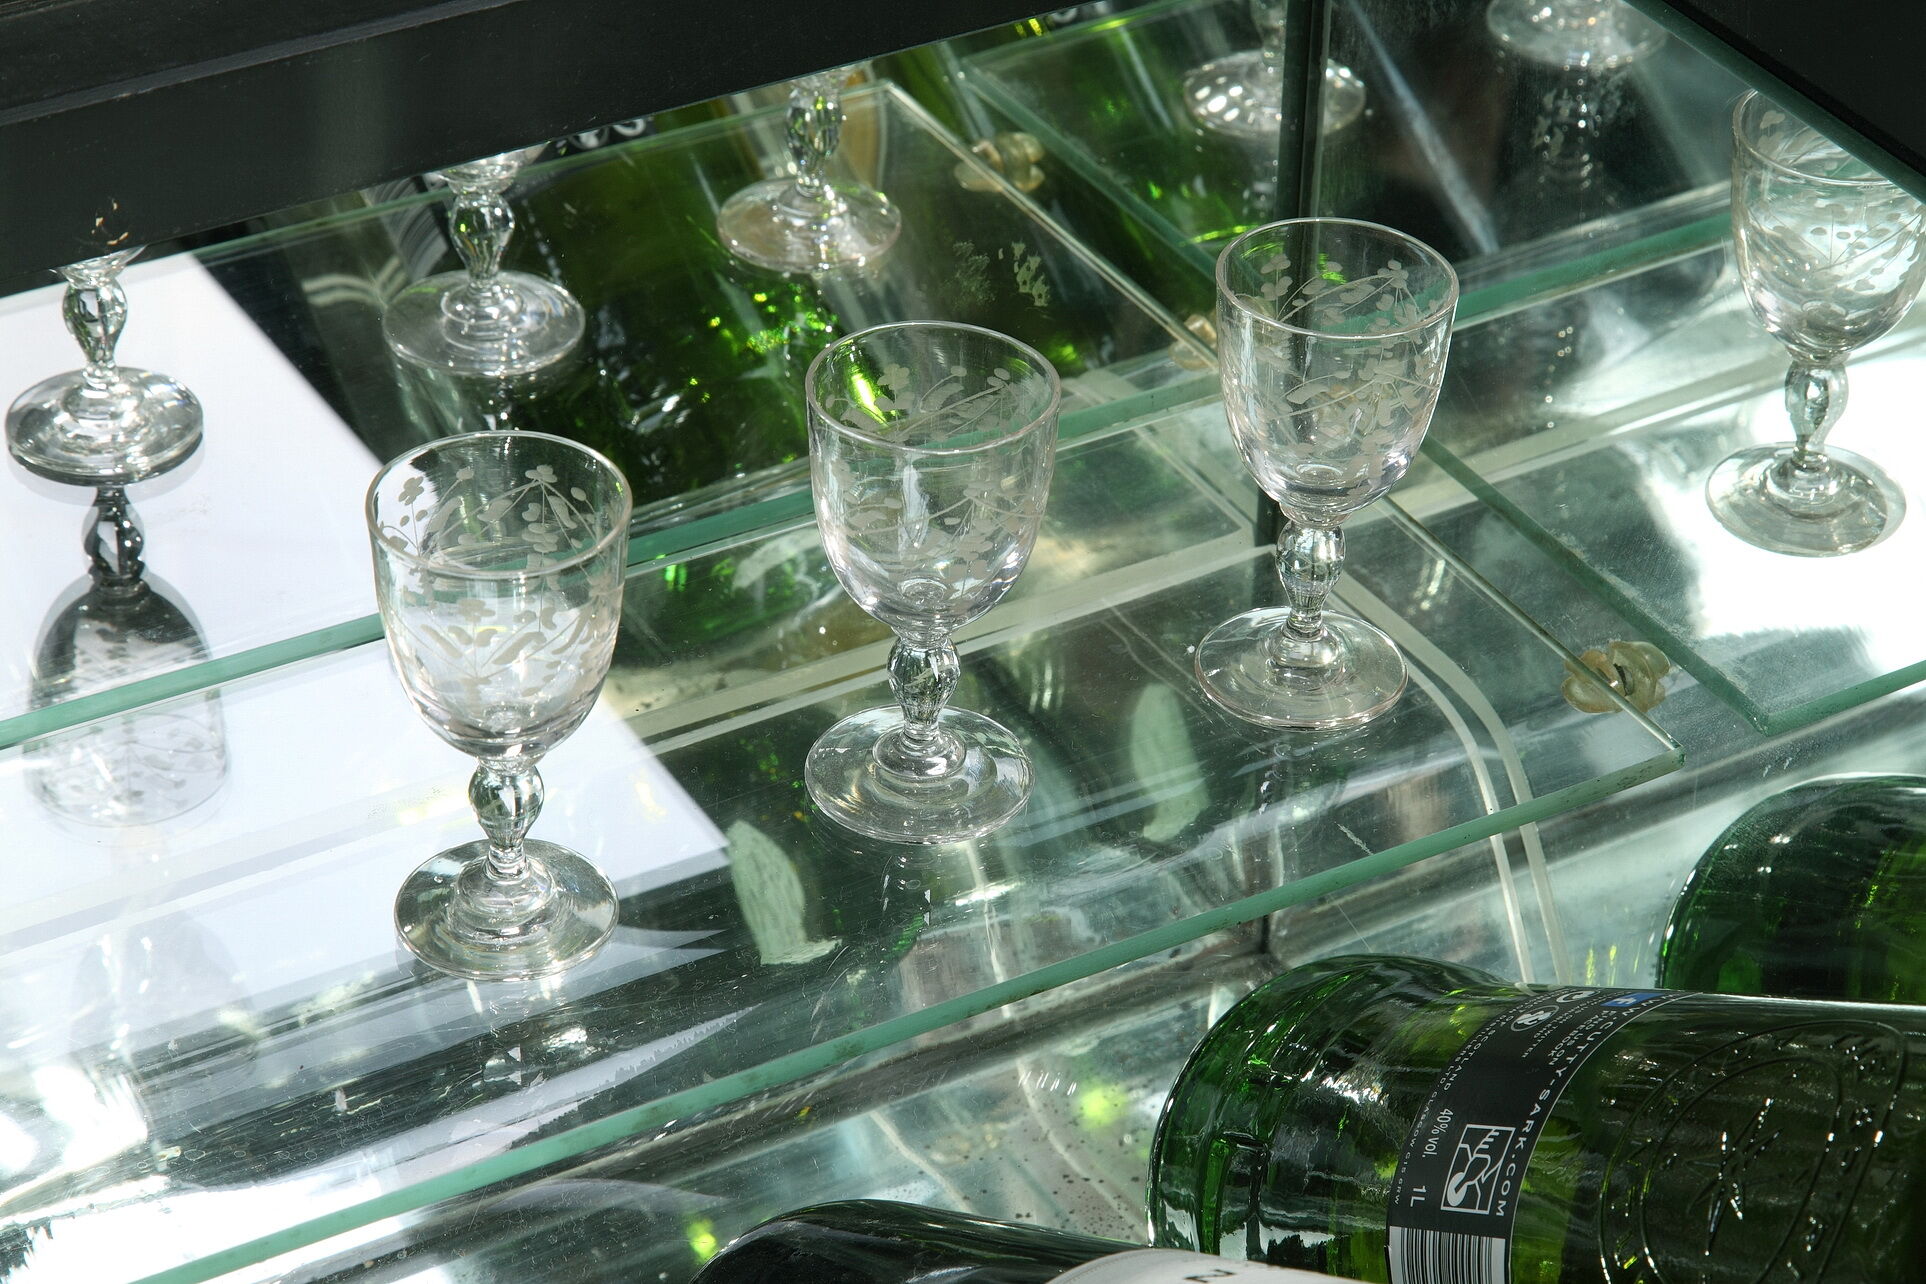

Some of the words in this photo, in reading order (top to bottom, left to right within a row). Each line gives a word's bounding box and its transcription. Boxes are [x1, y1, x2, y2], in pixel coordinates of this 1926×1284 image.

[1499, 1014, 1515, 1028] OF
[1548, 1010, 1610, 1058] FACEBOOK
[1522, 1025, 1559, 1058] TWITTER
[1566, 1032, 1584, 1046] US
[1443, 1029, 1496, 1091] SCOTLAND
[1549, 1049, 1567, 1066] ON
[1409, 1091, 1438, 1148] GLASGOW
[1410, 1185, 1427, 1208] 1L
